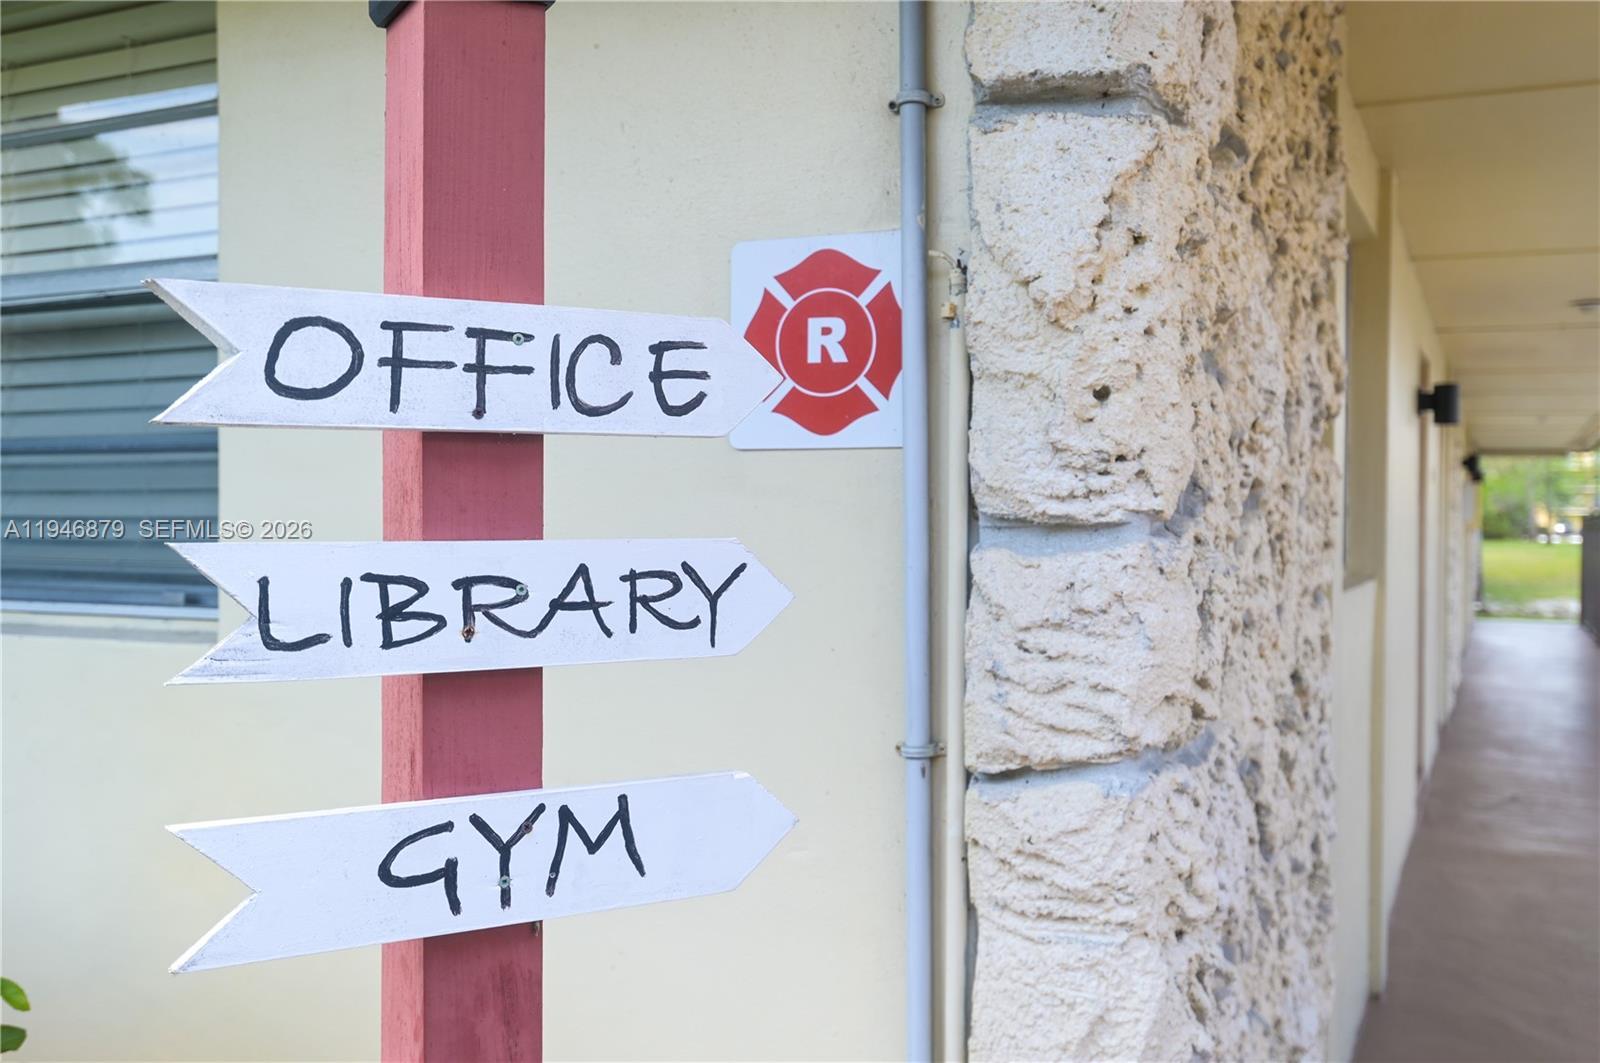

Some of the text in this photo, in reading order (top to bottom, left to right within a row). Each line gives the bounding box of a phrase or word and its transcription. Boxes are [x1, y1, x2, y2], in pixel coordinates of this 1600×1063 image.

[264, 316, 710, 419] OFFICE
[807, 316, 849, 364] R
[257, 561, 747, 652] LIBRARY
[377, 794, 646, 916] GYM
